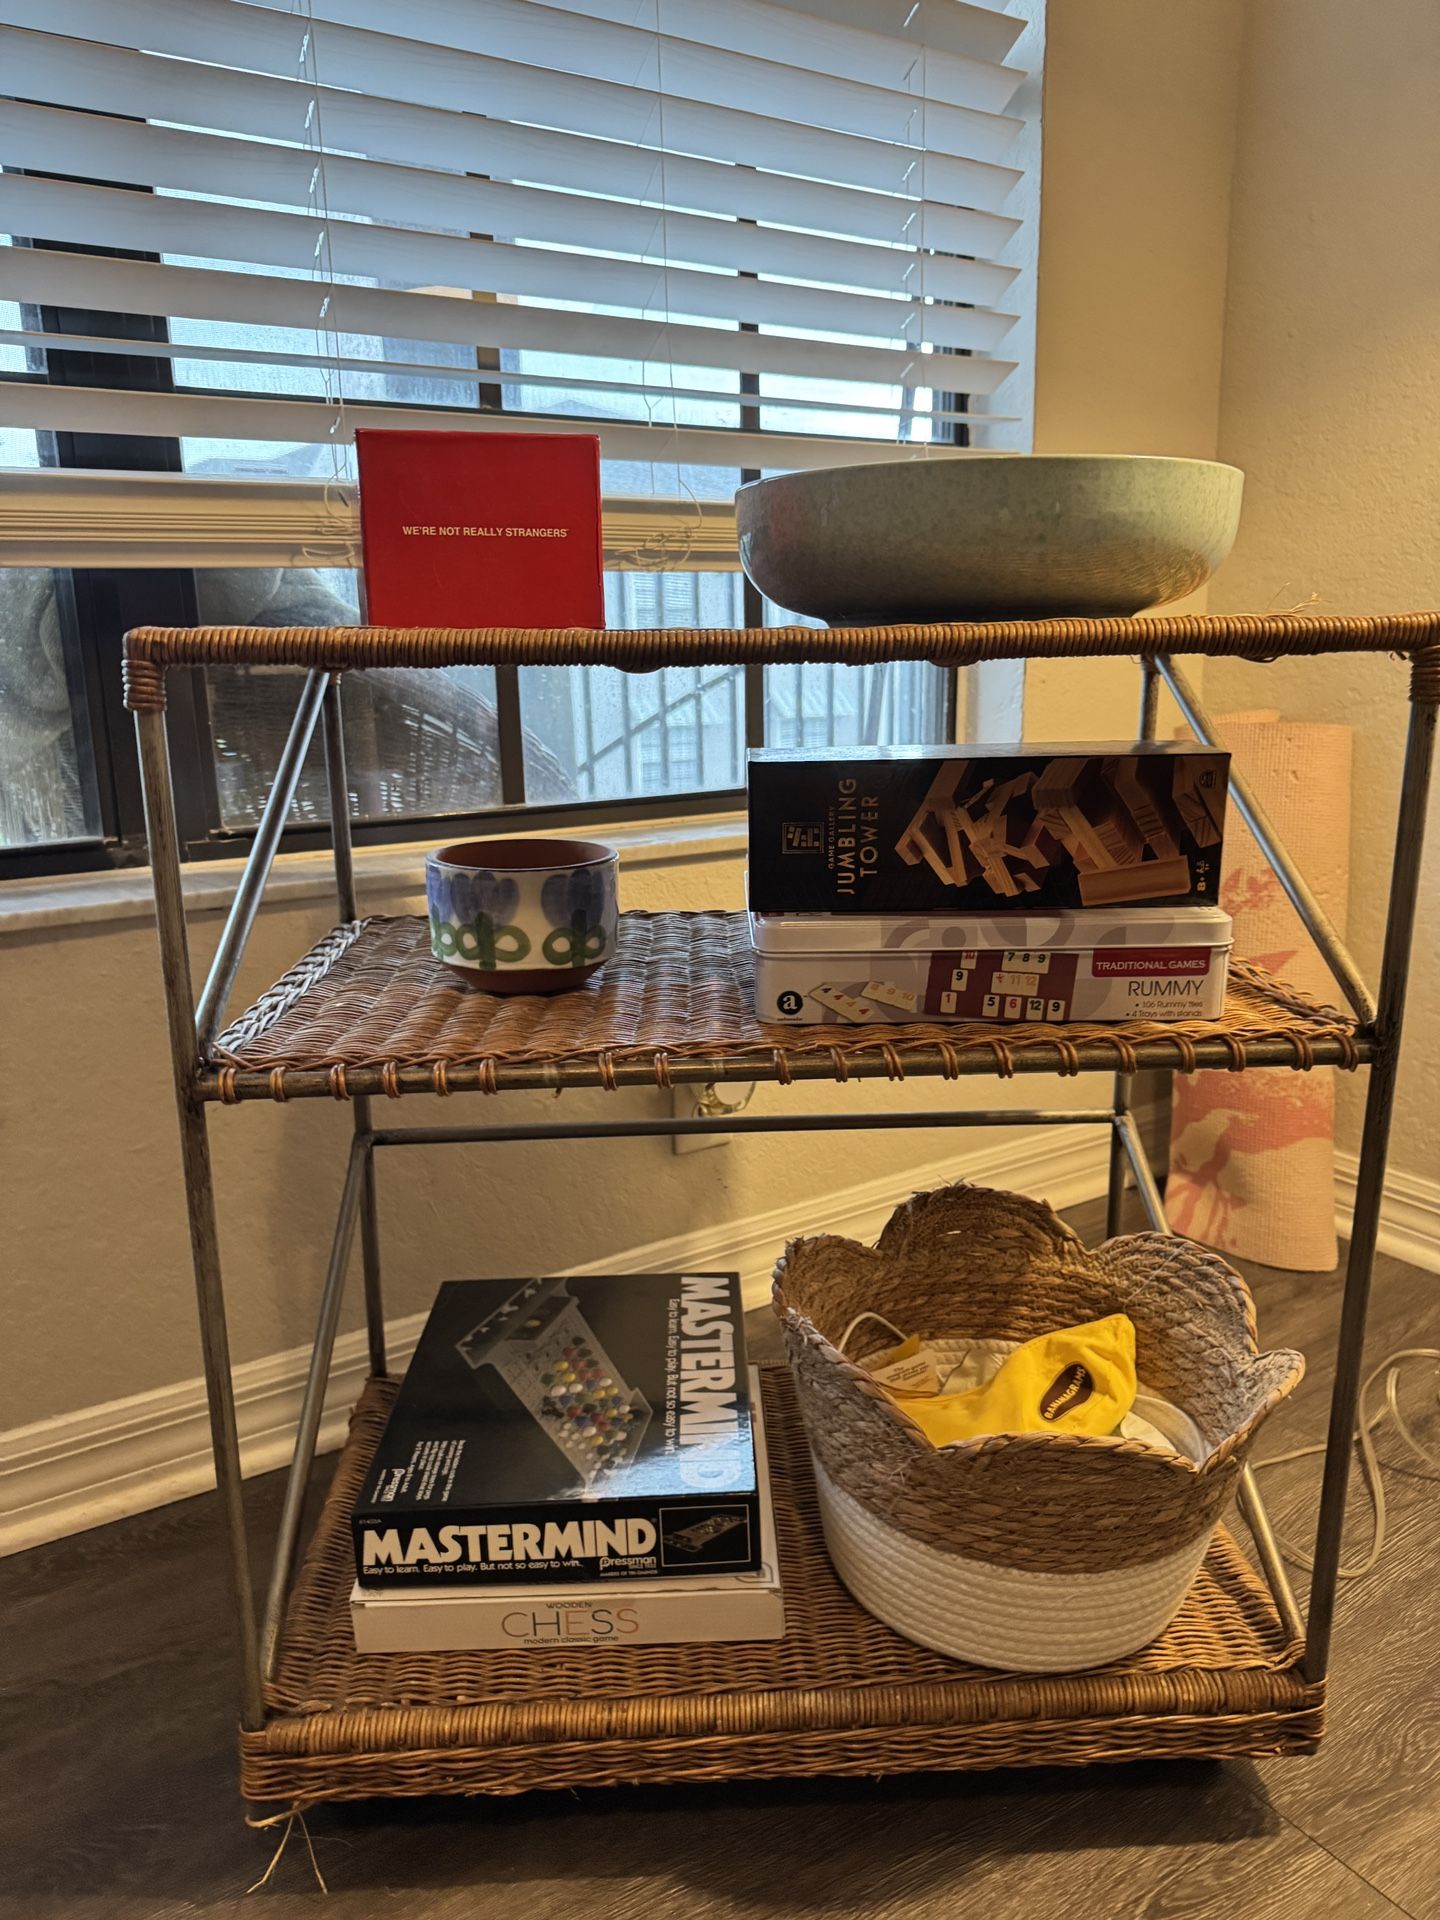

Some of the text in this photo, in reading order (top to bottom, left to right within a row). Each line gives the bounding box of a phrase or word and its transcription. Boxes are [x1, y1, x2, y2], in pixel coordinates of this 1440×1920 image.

[402, 525, 568, 538] WE'RE NOT REALLY STRANGERS
[827, 805, 836, 870] GAME GALLERY
[836, 778, 857, 895] JUMBLING
[859, 796, 880, 878] TOWER
[1007, 951, 1046, 963] 7 8 9
[1095, 959, 1206, 971] TRADITIONAL GAMES
[955, 970, 964, 981] 9
[1127, 979, 1205, 997] RUMMY
[782, 994, 798, 1010] a
[986, 996, 996, 1007] 5
[1009, 998, 1017, 1009] 6
[1029, 1000, 1042, 1011] 12
[1052, 1001, 1061, 1012] 9
[667, 1298, 680, 1311] Easy
[665, 1335, 680, 1349] Easy
[667, 1349, 679, 1357] to
[666, 1374, 679, 1386] But
[680, 1276, 742, 1489] MASTERMIND
[666, 1387, 678, 1399] not
[1043, 1366, 1086, 1419] BANANAGRAMS
[666, 1400, 676, 1409] so
[662, 1410, 676, 1427] easy
[665, 1428, 678, 1438] to
[363, 1517, 657, 1566] MASTERMIND
[363, 1566, 384, 1576] Easy
[384, 1566, 395, 1574] to
[396, 1565, 420, 1574] learn.
[423, 1564, 444, 1574] Easy
[444, 1563, 455, 1572] to
[456, 1563, 478, 1574] play.
[480, 1562, 496, 1571] But
[497, 1562, 513, 1571] not
[515, 1562, 526, 1570] so
[528, 1561, 549, 1571] easy
[550, 1560, 561, 1568] to
[545, 1601, 593, 1609] WOODEN
[501, 1608, 639, 1638] CHESS
[523, 1635, 619, 1645] modern classic game
